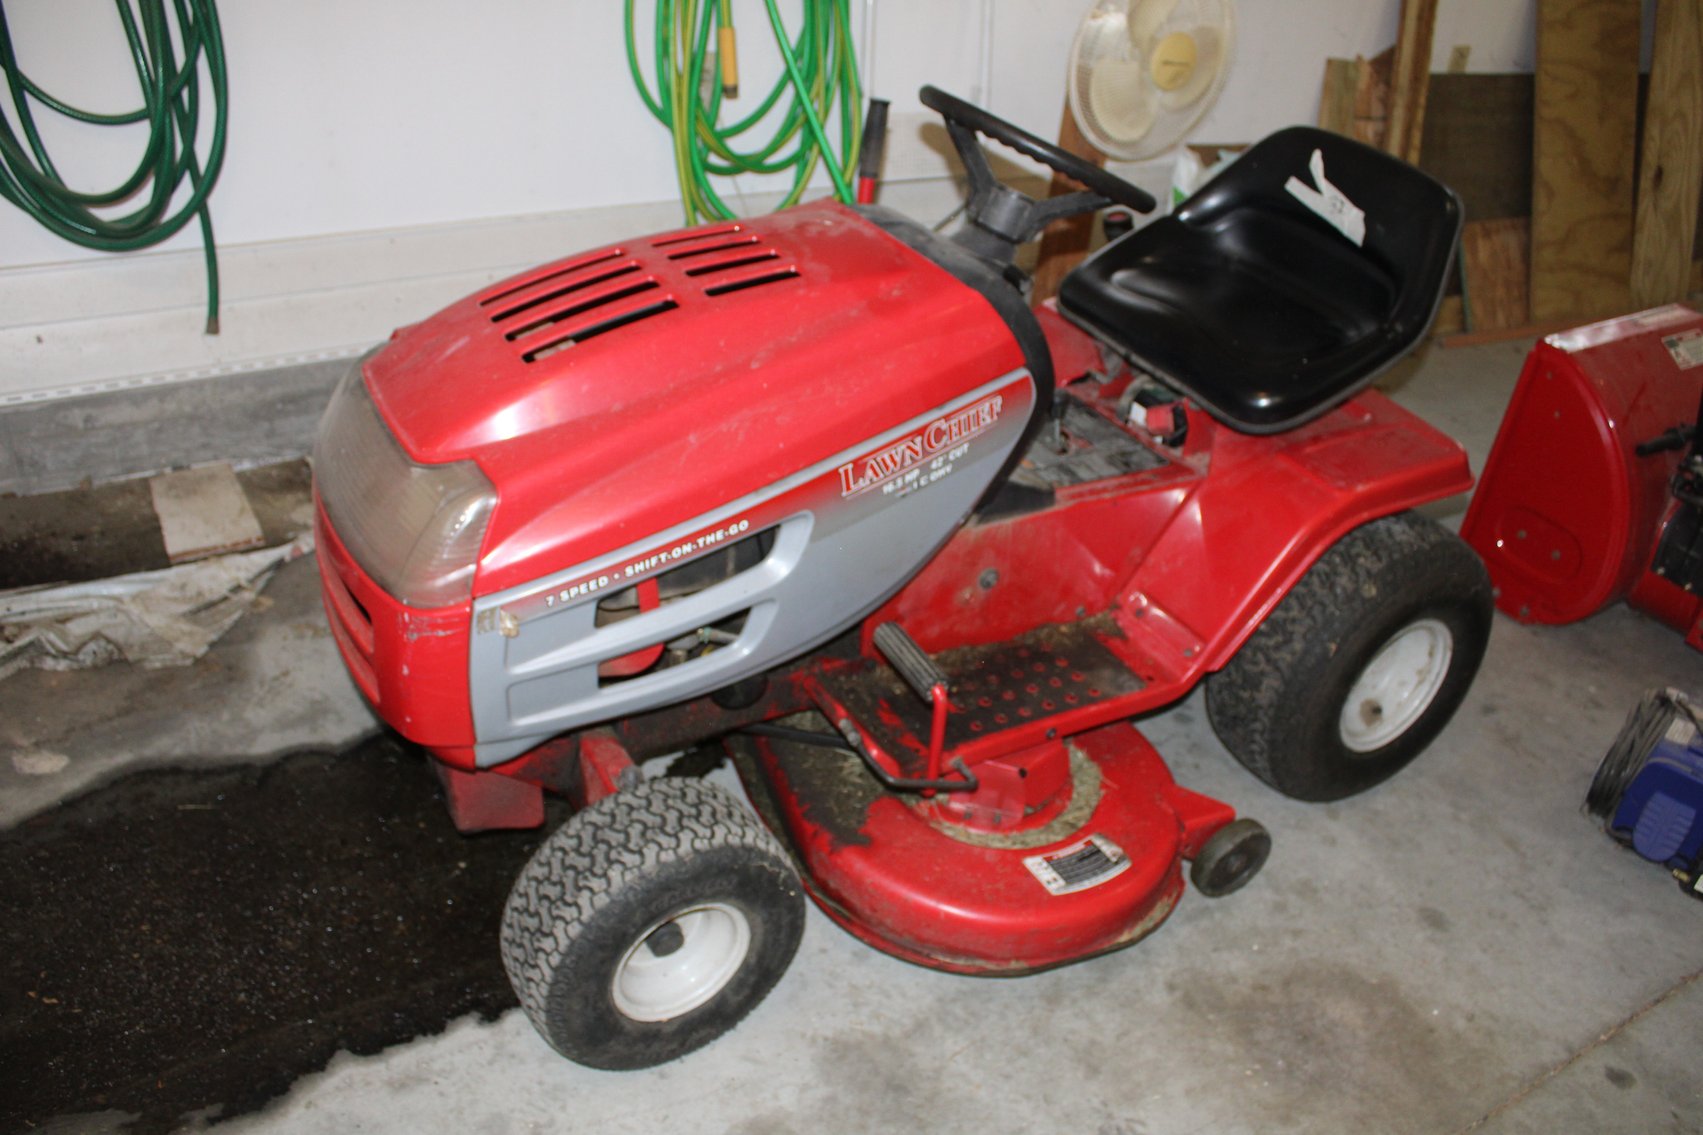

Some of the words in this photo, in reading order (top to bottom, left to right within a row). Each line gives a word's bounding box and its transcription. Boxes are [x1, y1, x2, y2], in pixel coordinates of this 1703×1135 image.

[838, 435, 923, 497] LAWN
[924, 394, 1003, 453] CHIEF
[948, 442, 970, 461] CUT
[546, 595, 555, 607] 7
[559, 575, 609, 602] SPEED
[624, 519, 750, 578] SHIFT-ON-THE-GO
